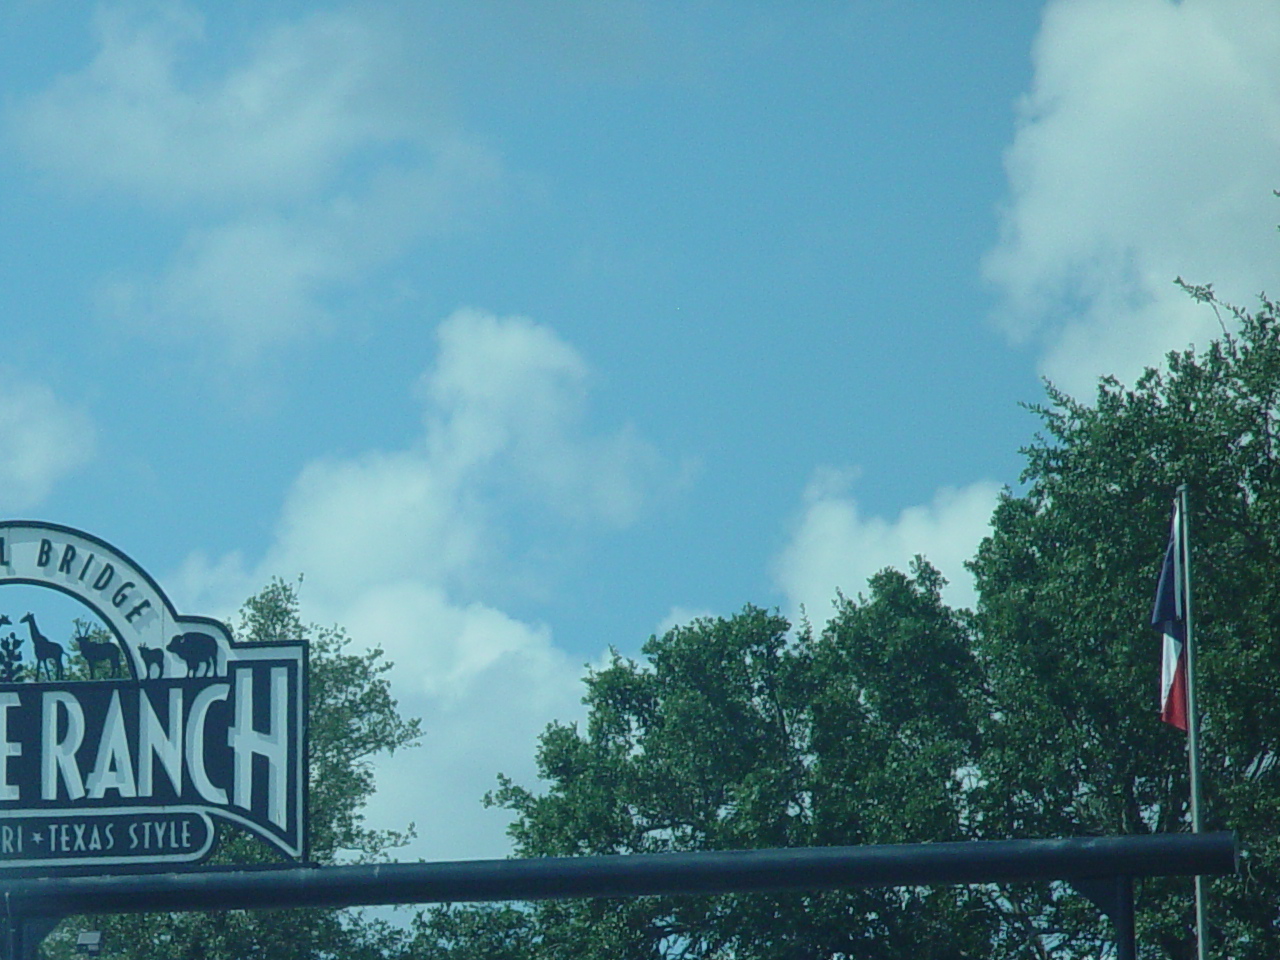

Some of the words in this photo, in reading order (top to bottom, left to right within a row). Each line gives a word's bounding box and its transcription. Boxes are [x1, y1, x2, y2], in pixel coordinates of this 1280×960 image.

[37, 538, 151, 624] BRIDGE
[41, 667, 288, 832] RANCH
[48, 823, 115, 851] TEXAS
[129, 820, 191, 849] STYLE
